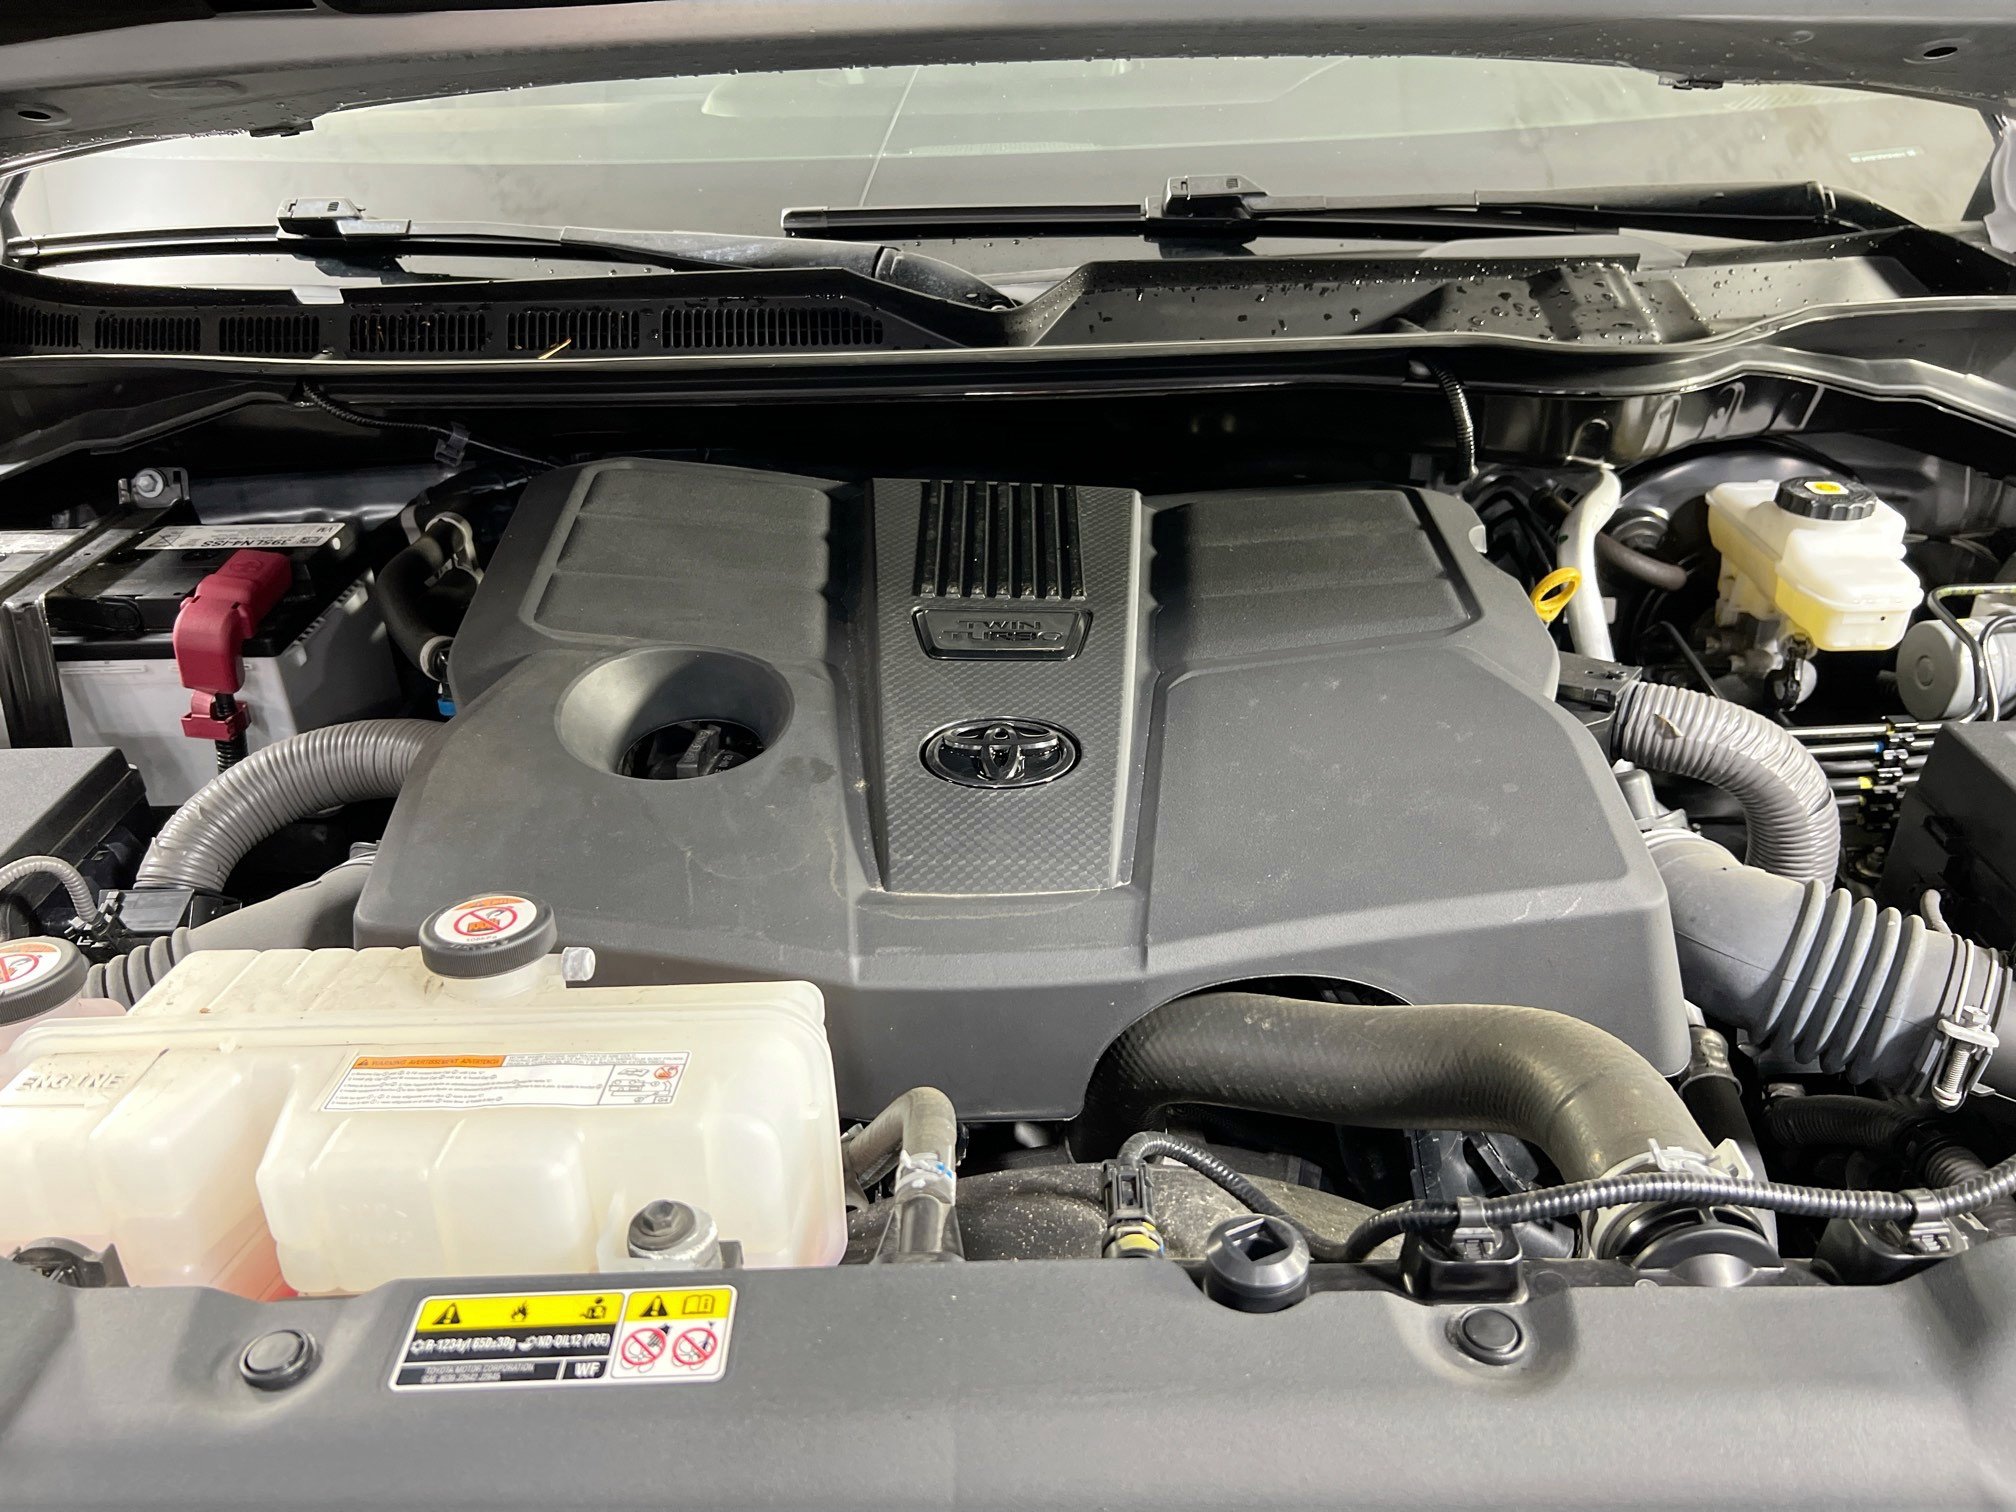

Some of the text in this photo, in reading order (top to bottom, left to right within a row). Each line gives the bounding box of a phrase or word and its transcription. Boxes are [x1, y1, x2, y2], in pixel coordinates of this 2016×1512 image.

[958, 620, 1041, 630] TWIN
[942, 631, 1063, 641] TURBO
[574, 1362, 601, 1378] WF
